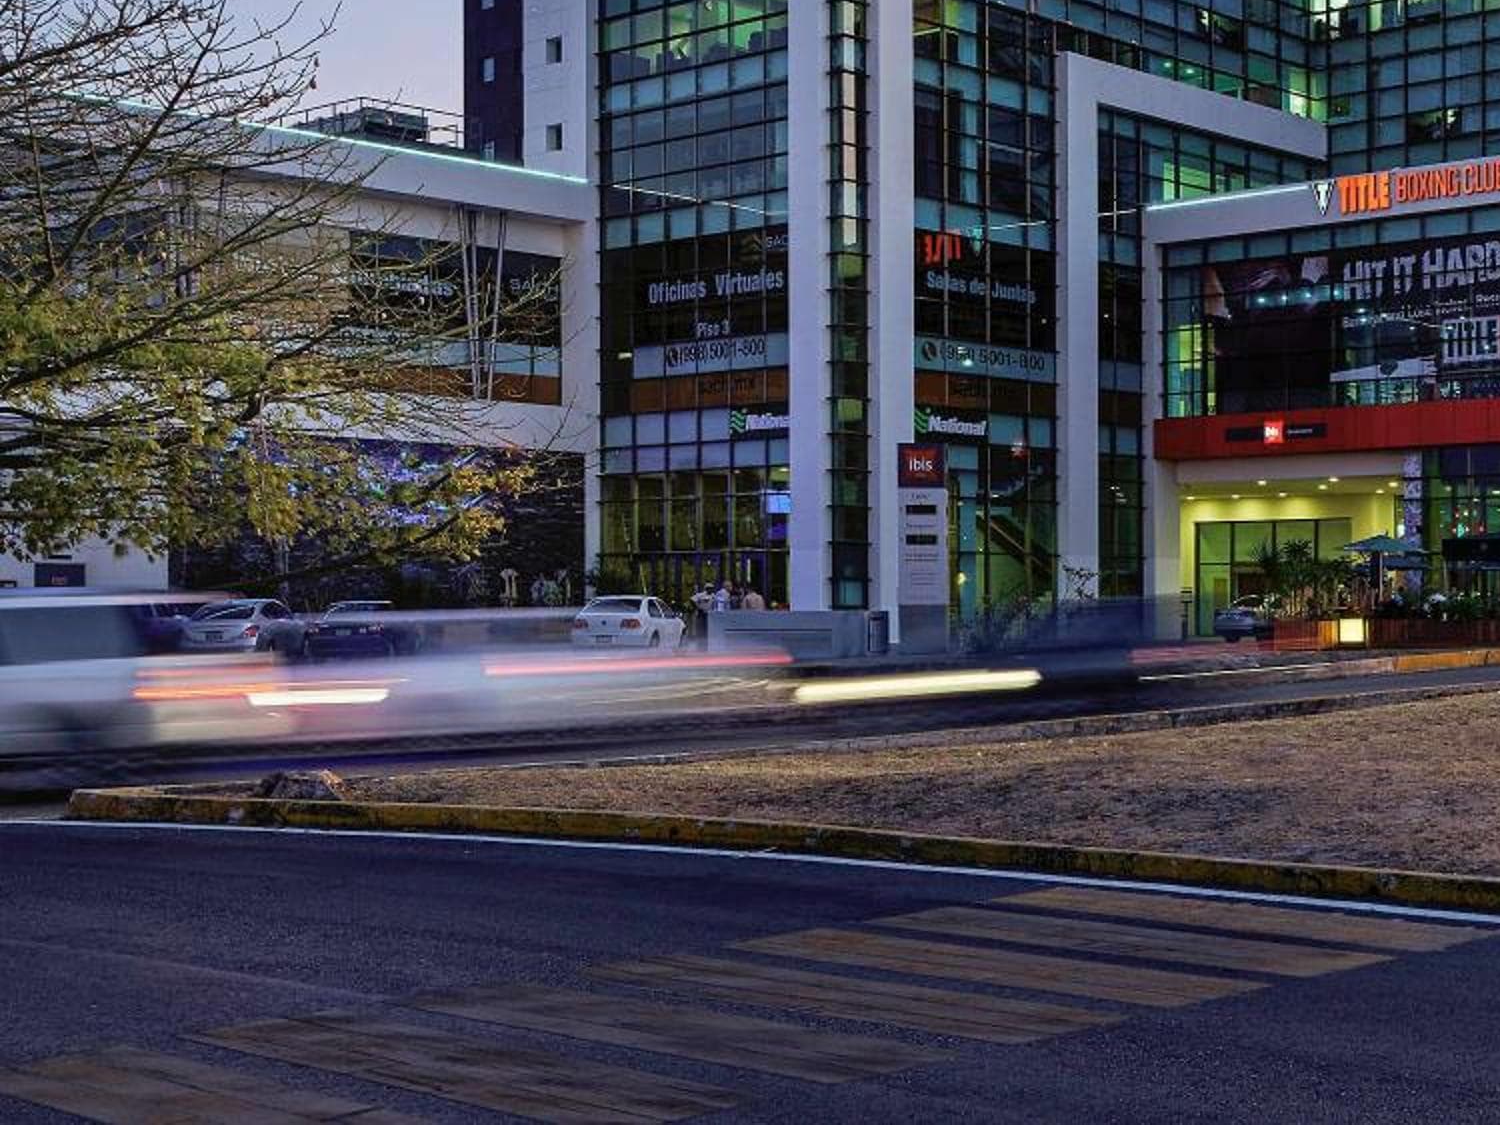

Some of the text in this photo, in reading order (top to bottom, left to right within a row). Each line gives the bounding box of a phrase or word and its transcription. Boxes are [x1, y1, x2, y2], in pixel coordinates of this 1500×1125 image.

[1336, 171, 1392, 216] TITLE
[1396, 167, 1460, 202] BOXING
[649, 268, 784, 304] Oficinas Virtuales
[1343, 260, 1387, 300] HIT
[1393, 255, 1417, 295] IT
[927, 414, 987, 436] National
[909, 456, 933, 472] ibis
